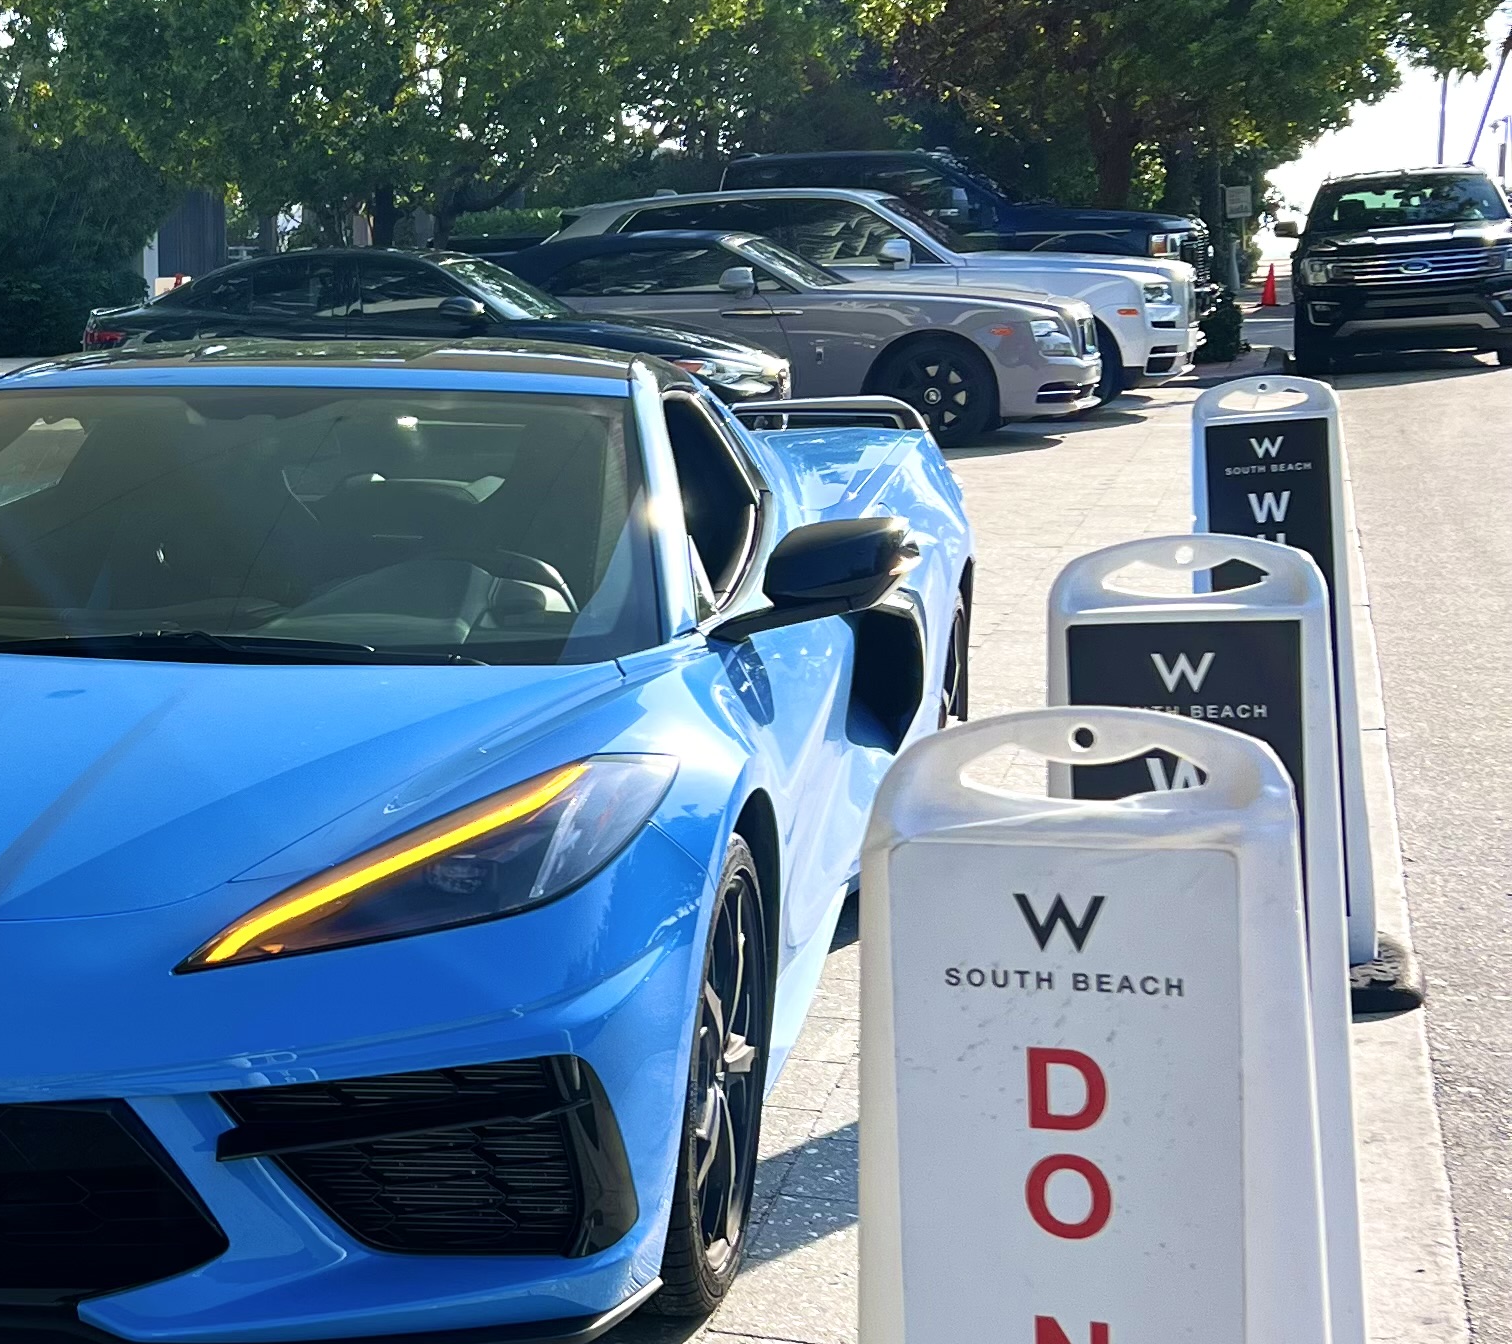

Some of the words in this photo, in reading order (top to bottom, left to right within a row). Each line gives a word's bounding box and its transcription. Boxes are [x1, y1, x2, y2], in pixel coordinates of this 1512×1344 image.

[1249, 435, 1284, 459] W
[1224, 464, 1266, 476] SOUTH
[1270, 461, 1313, 473] BEACH
[1150, 651, 1216, 694] W
[1190, 704, 1268, 719] BEACH
[1012, 892, 1106, 953] W
[944, 966, 1054, 991] SOUTH
[1072, 972, 1184, 997] BEACH
[1026, 1047, 1111, 1240] DO
